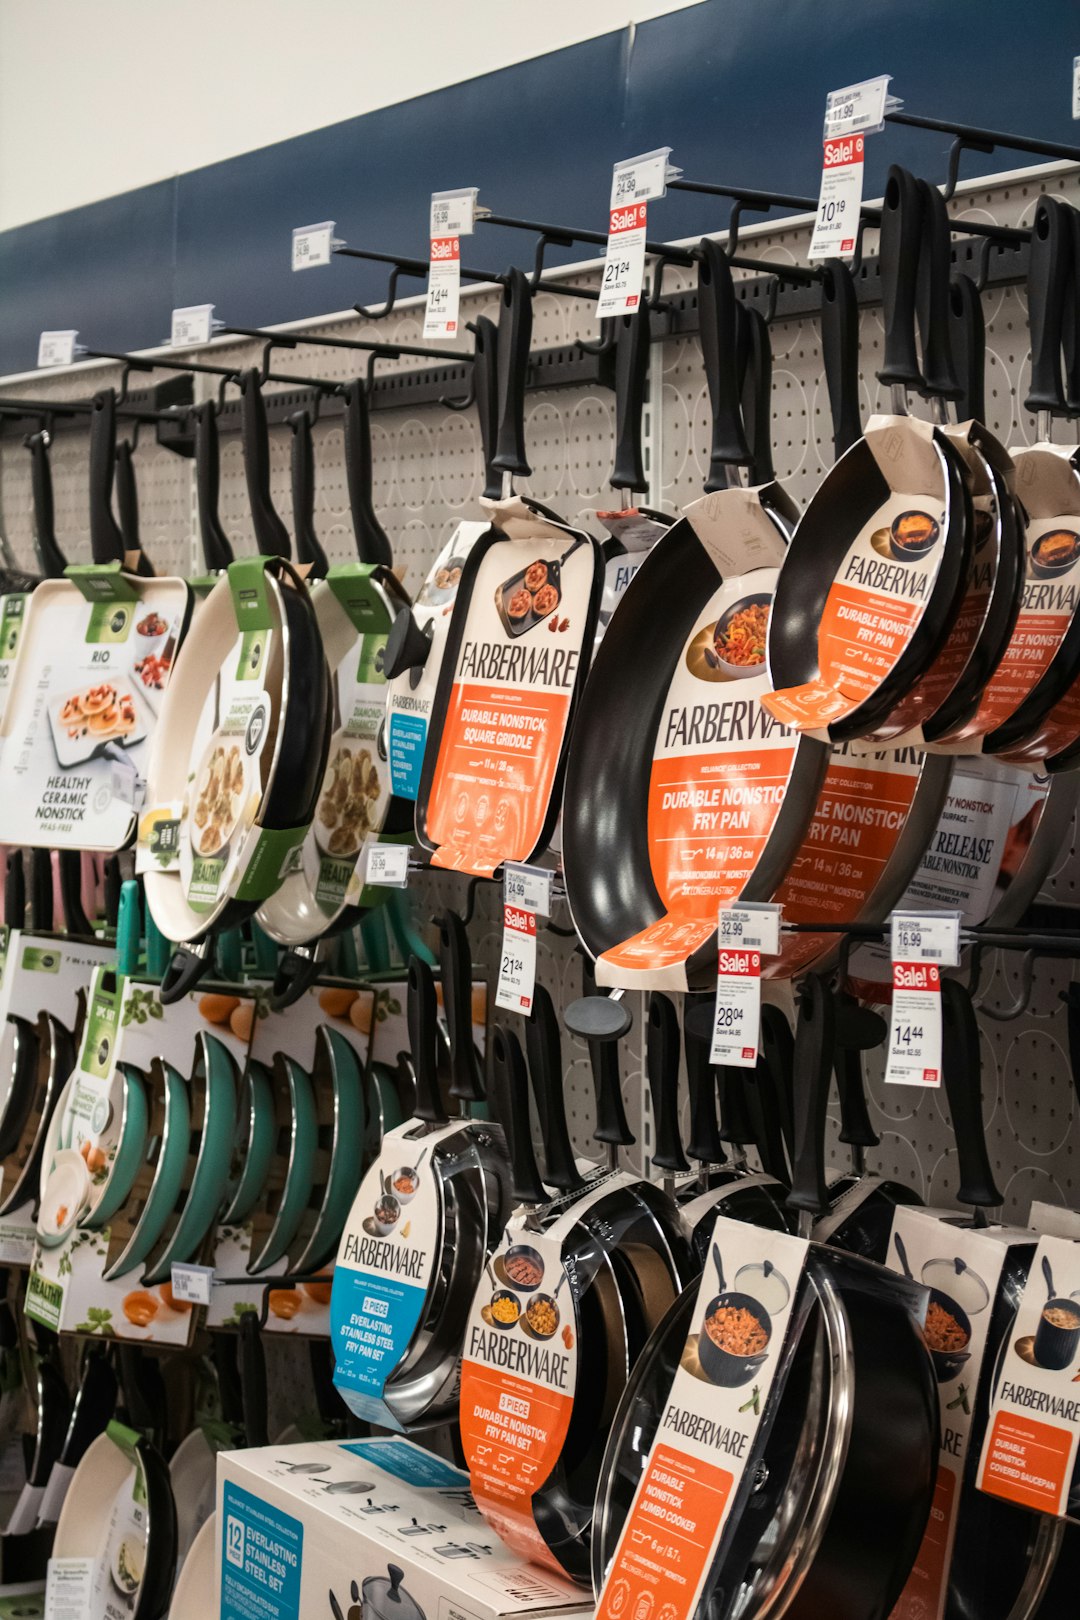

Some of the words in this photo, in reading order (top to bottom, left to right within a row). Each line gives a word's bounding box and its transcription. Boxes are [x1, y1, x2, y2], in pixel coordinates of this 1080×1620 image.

[833, 104, 854, 121] 11.99
[824, 140, 853, 165] Sale!
[616, 179, 636, 196] 24.99
[610, 206, 637, 231] Sale!
[431, 241, 453, 259] Sale!
[837, 606, 879, 628] DURABLE
[856, 627, 876, 643] FRY
[875, 632, 895, 648] PAN
[92, 651, 110, 663] RIO
[459, 641, 579, 688] FARBERWARE
[1022, 648, 1045, 660] PAN
[461, 709, 499, 726] DURABLE
[499, 712, 546, 732] NONSTICK
[392, 728, 422, 741] EVERLASTING
[392, 739, 416, 751] STAINLESS
[464, 727, 496, 744] SQUARE
[496, 732, 533, 750] GRIDDLE
[392, 749, 405, 759] STEEL
[392, 759, 413, 771] COVERED
[47, 776, 92, 789] HEALTHY
[839, 779, 874, 790] COLLECTION
[42, 791, 88, 806] CERAMIC
[662, 788, 721, 810] DURABLE
[955, 799, 995, 815] NONSTICK
[35, 806, 86, 821] NONSTICK
[692, 812, 721, 830] FRY
[720, 811, 751, 829] PAN
[942, 811, 968, 824] SURFACE
[830, 826, 862, 847] PAN
[705, 847, 716, 859] 14
[729, 846, 743, 859] 36
[743, 851, 754, 859] CM
[936, 832, 994, 865] RELEASE
[814, 858, 825, 871] 14
[838, 863, 852, 878] 36
[852, 869, 863, 879] CM
[940, 859, 981, 880] NONSTICK
[508, 882, 525, 896] 24.99
[504, 908, 528, 930] Sale!
[721, 921, 743, 936] 32.99
[898, 932, 922, 947] 16.99
[719, 952, 749, 973] Sale!
[894, 965, 928, 987] Sale!
[716, 1027, 728, 1036] Save
[892, 1047, 906, 1055] Save
[343, 1234, 426, 1280] FARBERWARE
[30, 1275, 63, 1307] HEALTHY
[364, 1299, 369, 1310] 2
[369, 1301, 388, 1316] PIECE
[350, 1313, 393, 1336] EVERLASTING
[340, 1325, 376, 1346] STAINLESS
[375, 1336, 394, 1351] STEEL
[345, 1341, 359, 1353] FRY
[358, 1345, 373, 1358] PAN
[373, 1350, 385, 1362] SET
[469, 1326, 569, 1390] FARBERWARE
[501, 1397, 506, 1407] 3
[507, 1398, 529, 1416] PIECE
[1000, 1381, 1080, 1422] FARBERWARE
[473, 1405, 509, 1428] DURABLE
[509, 1418, 548, 1443] NONSTICK
[662, 1405, 749, 1459] FARBERWARE
[485, 1424, 501, 1439] FRY
[500, 1430, 517, 1447] PAN
[516, 1436, 532, 1452] SET
[995, 1438, 1026, 1455] DURABLE
[992, 1450, 1026, 1468] NONSTICK
[650, 1468, 686, 1492] DURABLE
[990, 1462, 1020, 1479] COVERED
[1020, 1472, 1056, 1491] SAUCEPAN
[645, 1484, 684, 1509] NONSTICK
[640, 1500, 666, 1521] JUMBO
[665, 1511, 697, 1534] COOKER
[228, 1521, 241, 1552] 12
[276, 1521, 298, 1541] COLLECTION
[246, 1526, 297, 1568] EVERLASTING
[651, 1539, 658, 1550] 6
[667, 1547, 679, 1560] 5.7
[245, 1543, 286, 1578] STAINLESS
[245, 1560, 267, 1585] STEEL
[268, 1575, 284, 1594] SET
